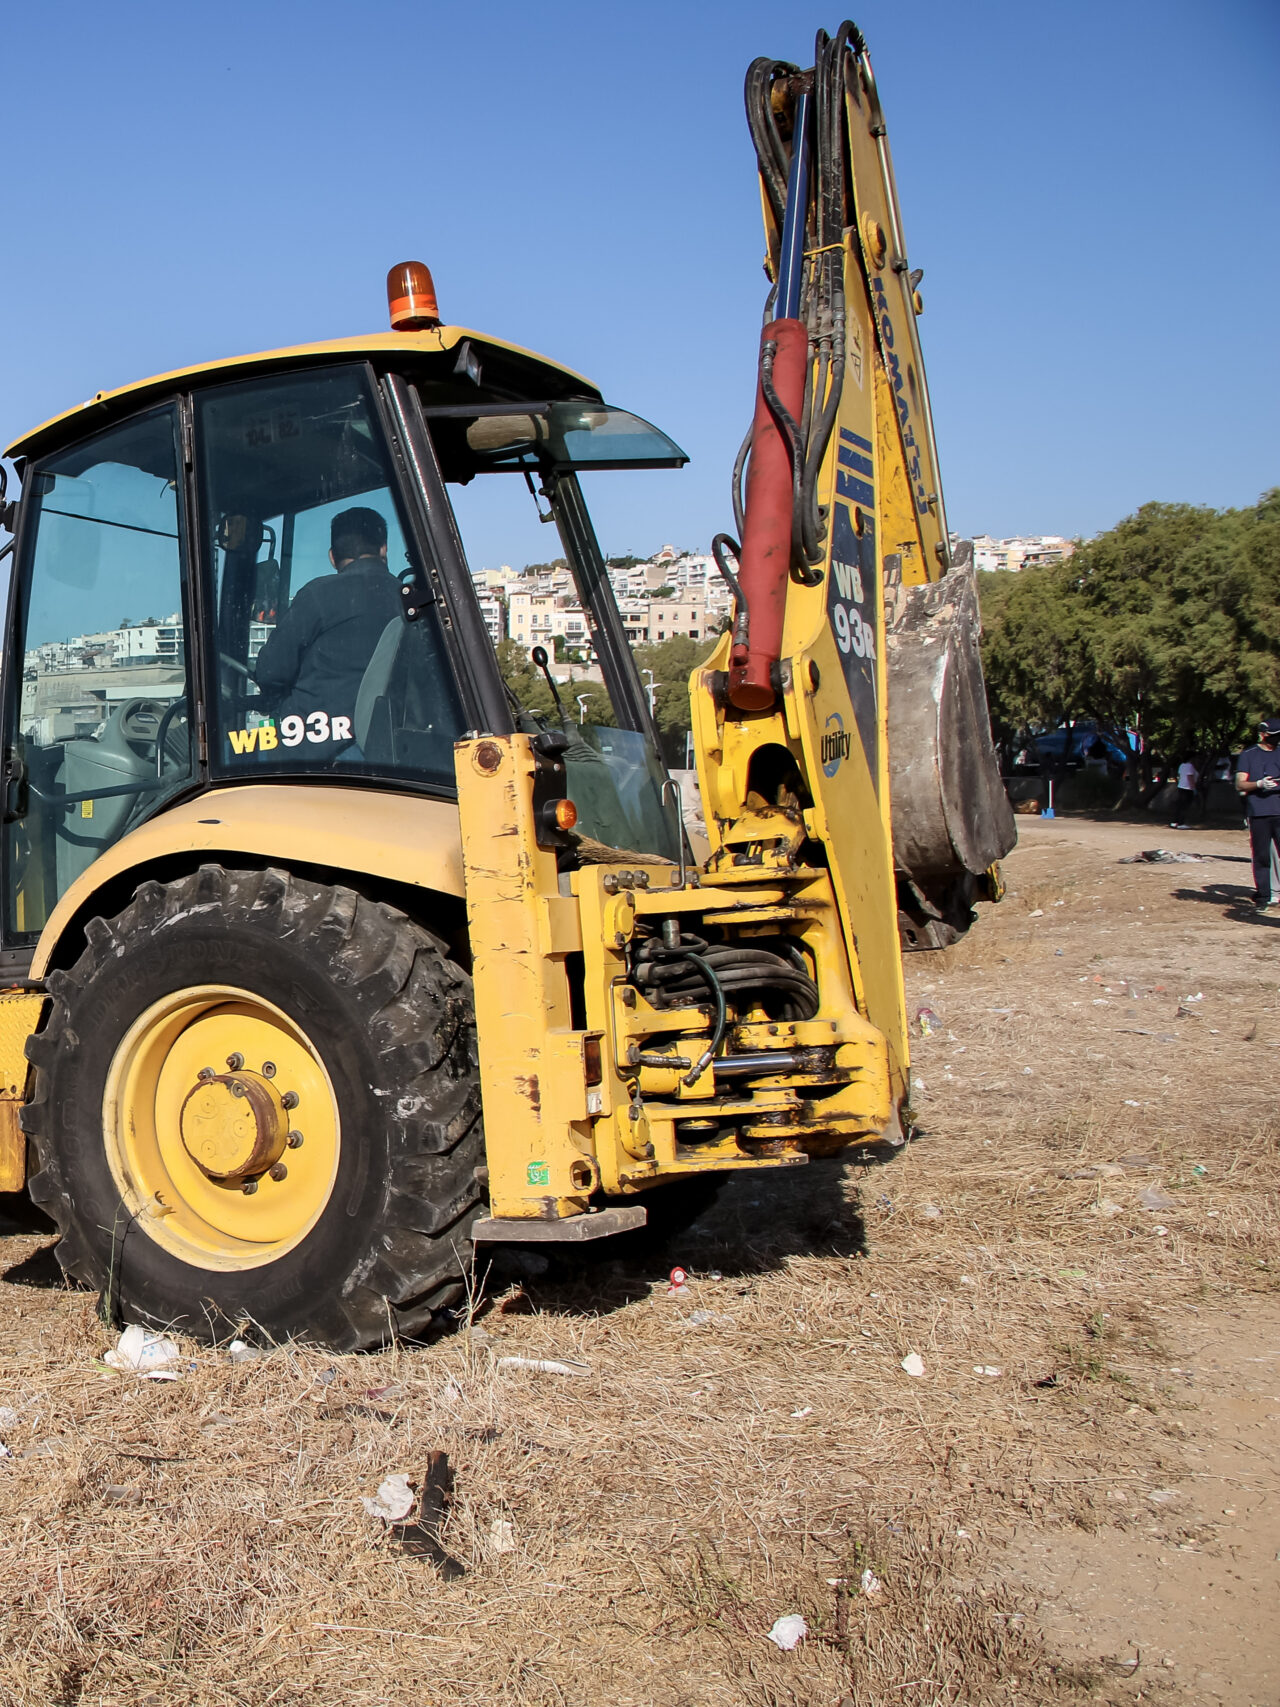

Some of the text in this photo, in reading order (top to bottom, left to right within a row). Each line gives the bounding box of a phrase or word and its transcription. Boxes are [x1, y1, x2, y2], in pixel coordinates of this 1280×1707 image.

[832, 560, 864, 603] WB
[834, 603, 876, 660] 93R
[821, 731, 851, 764] Utility
